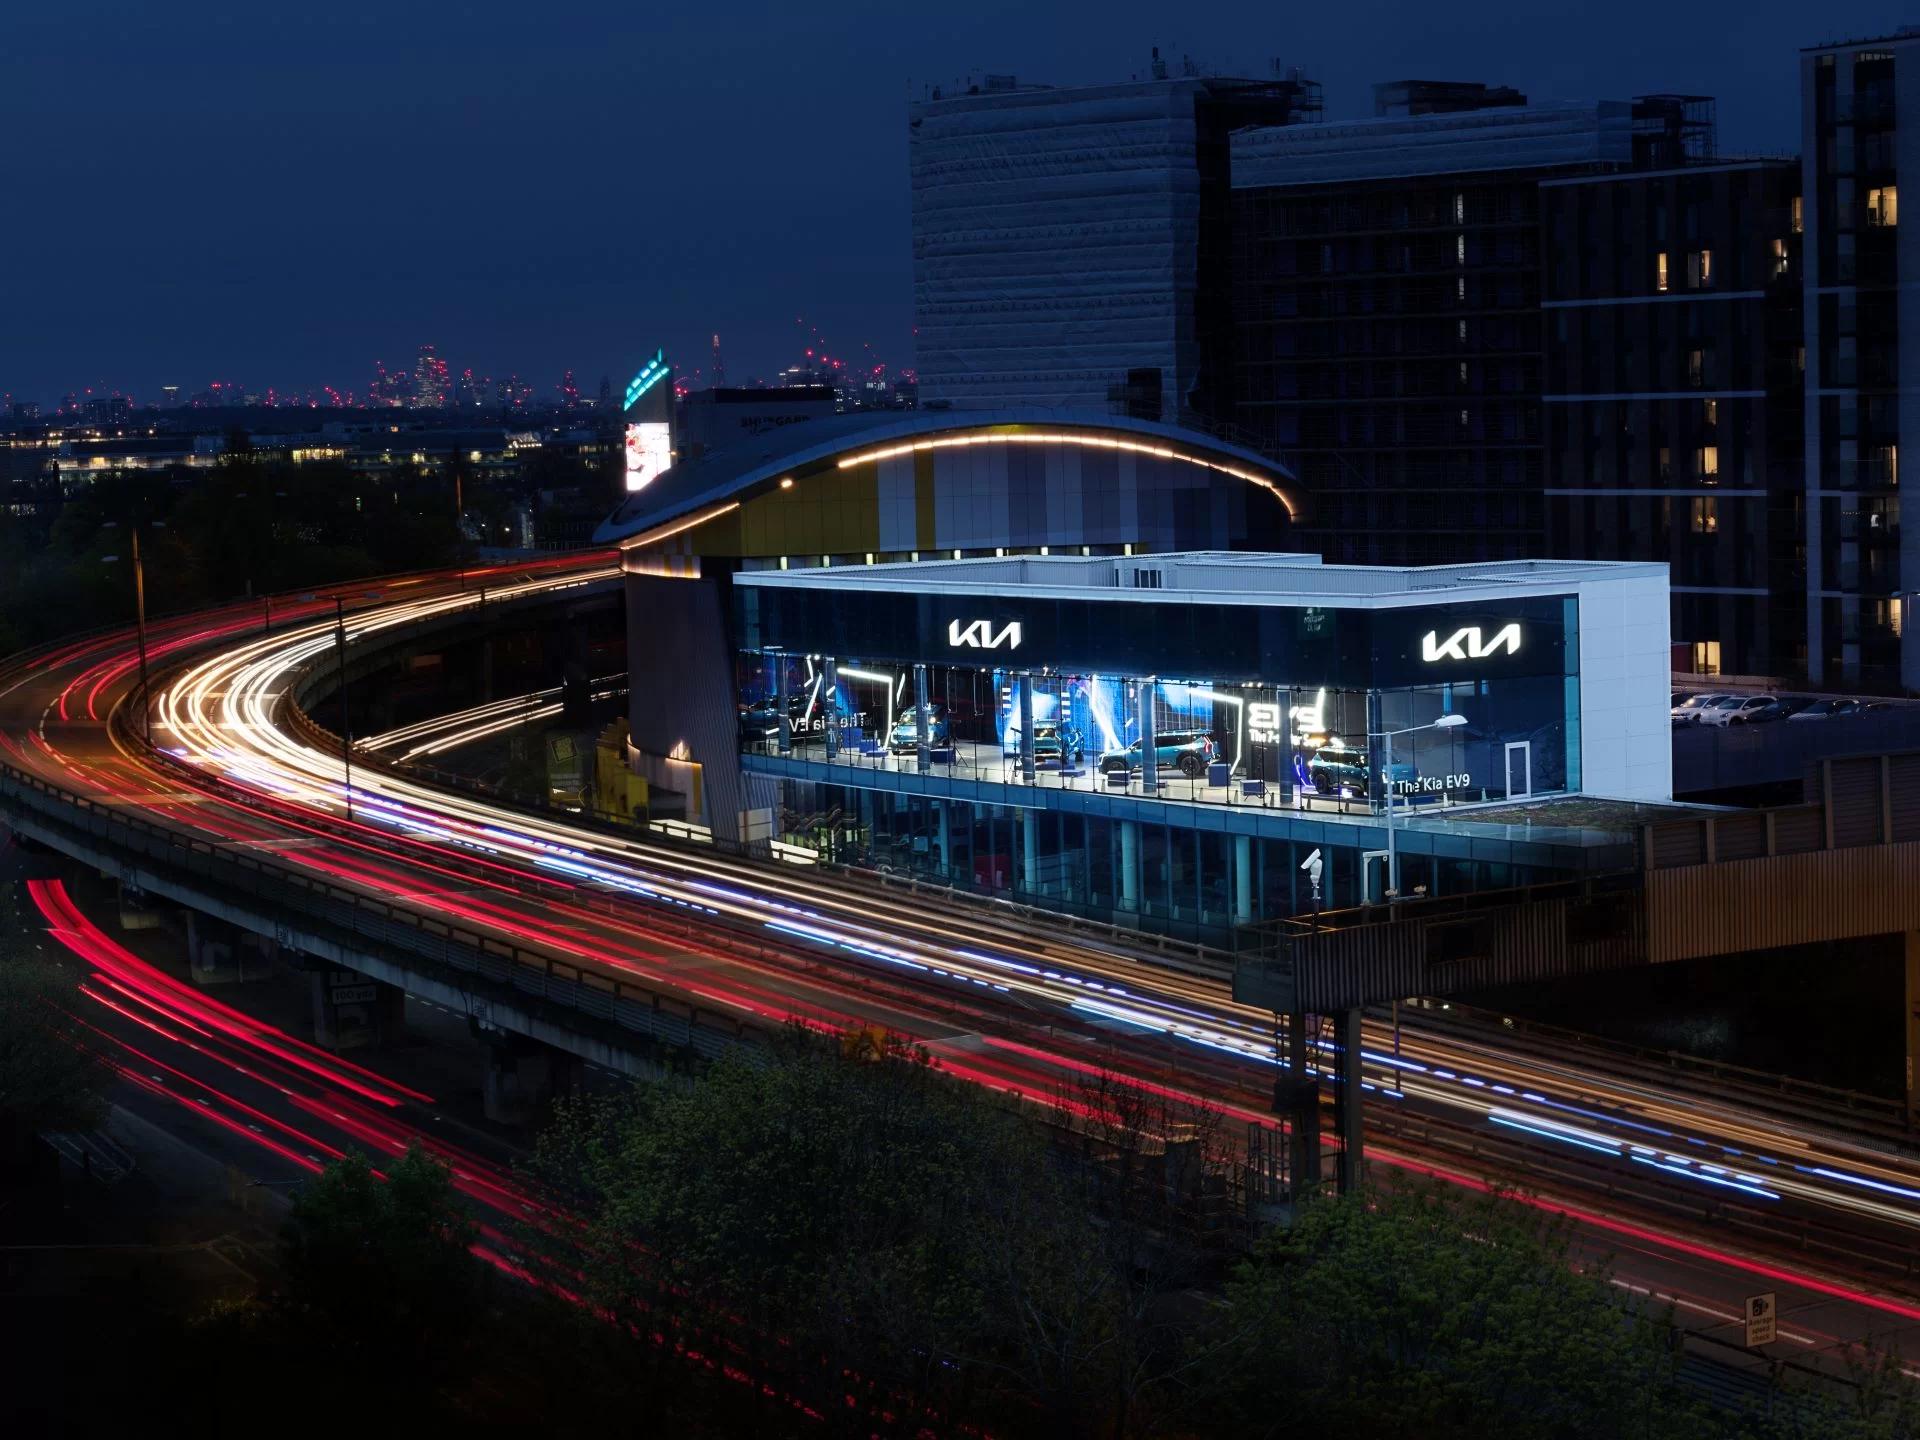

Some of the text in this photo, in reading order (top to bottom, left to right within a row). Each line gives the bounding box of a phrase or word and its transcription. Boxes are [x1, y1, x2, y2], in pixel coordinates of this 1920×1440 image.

[948, 618, 1022, 650] KIA
[1421, 622, 1521, 662] KIA
[1397, 773, 1470, 794] The Kia EV9
